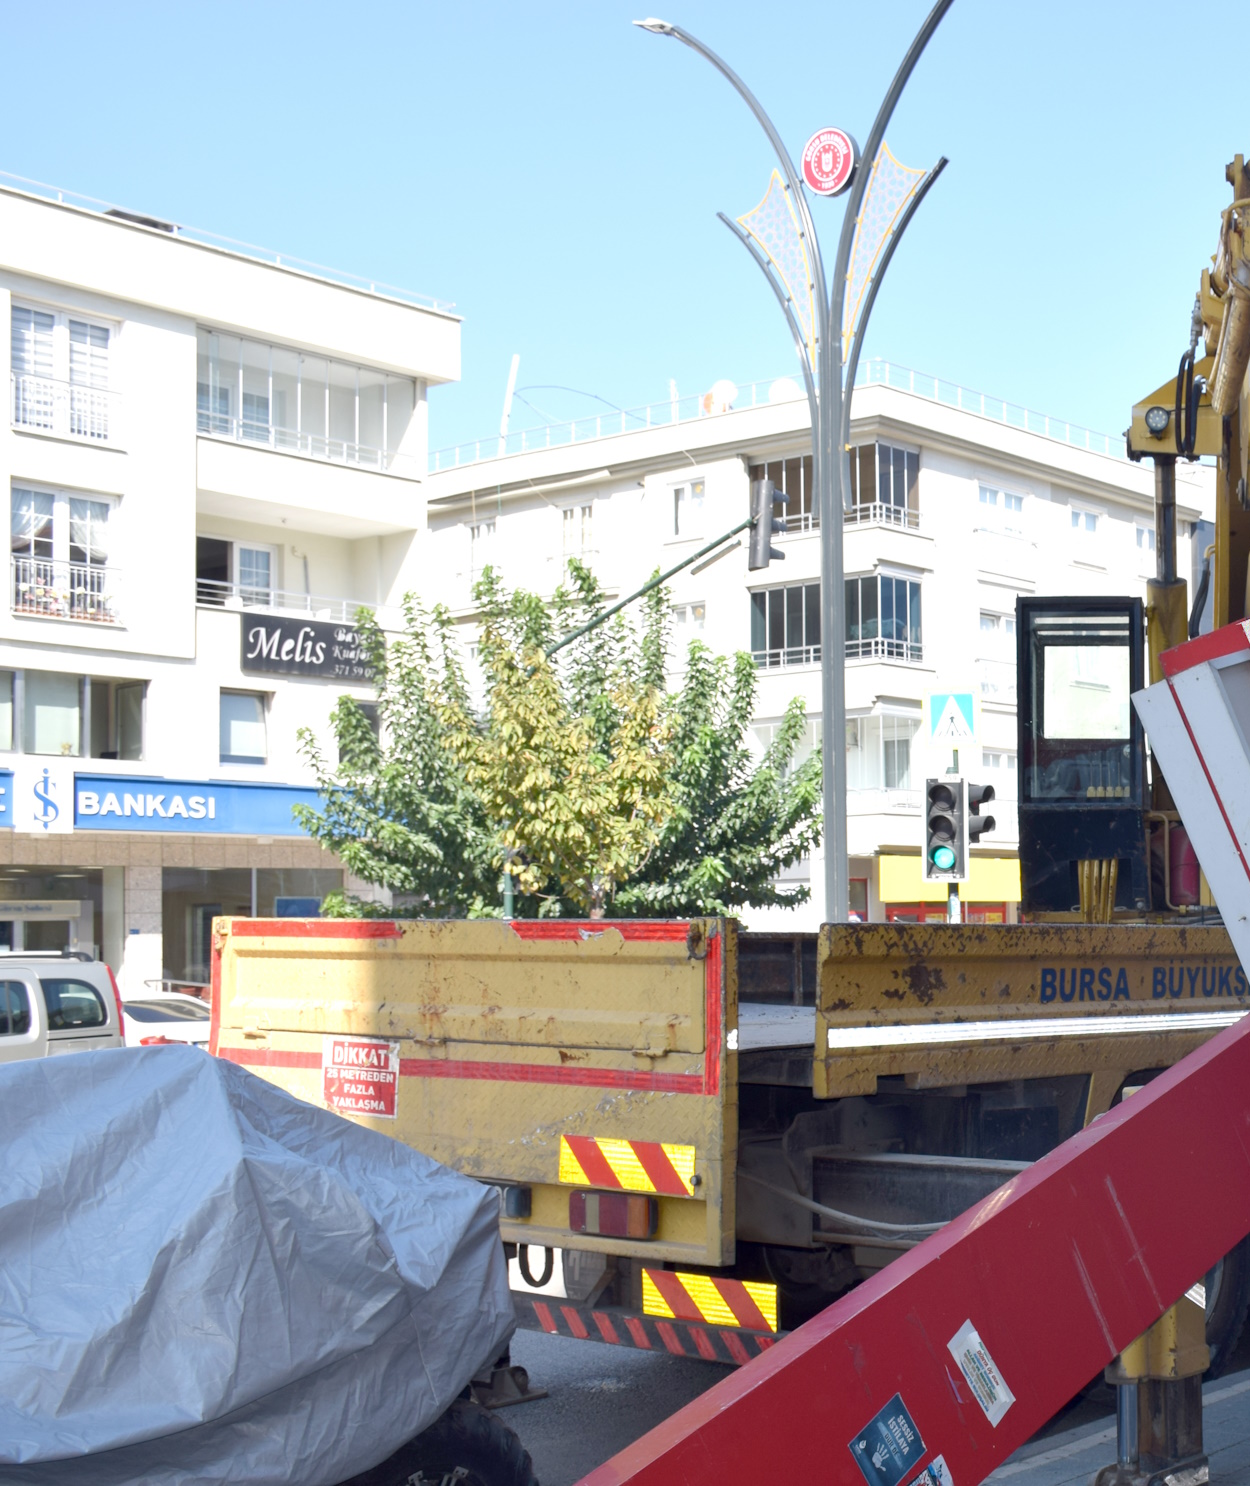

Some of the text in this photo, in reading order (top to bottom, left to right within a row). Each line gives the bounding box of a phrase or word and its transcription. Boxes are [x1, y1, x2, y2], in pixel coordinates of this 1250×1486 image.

[247, 627, 326, 664] Melis
[333, 664, 350, 676] 371
[77, 791, 216, 820] BANKASI
[1040, 967, 1131, 1004] BURSA
[333, 1042, 387, 1067] DİKKAT
[326, 1068, 394, 1083] 25 METREDEN
[343, 1083, 375, 1096] FAZLA
[332, 1096, 386, 1111] YAKLAŞMA
[888, 1416, 910, 1456] İSTİLAYA
[897, 1414, 915, 1443] SESSİZ
